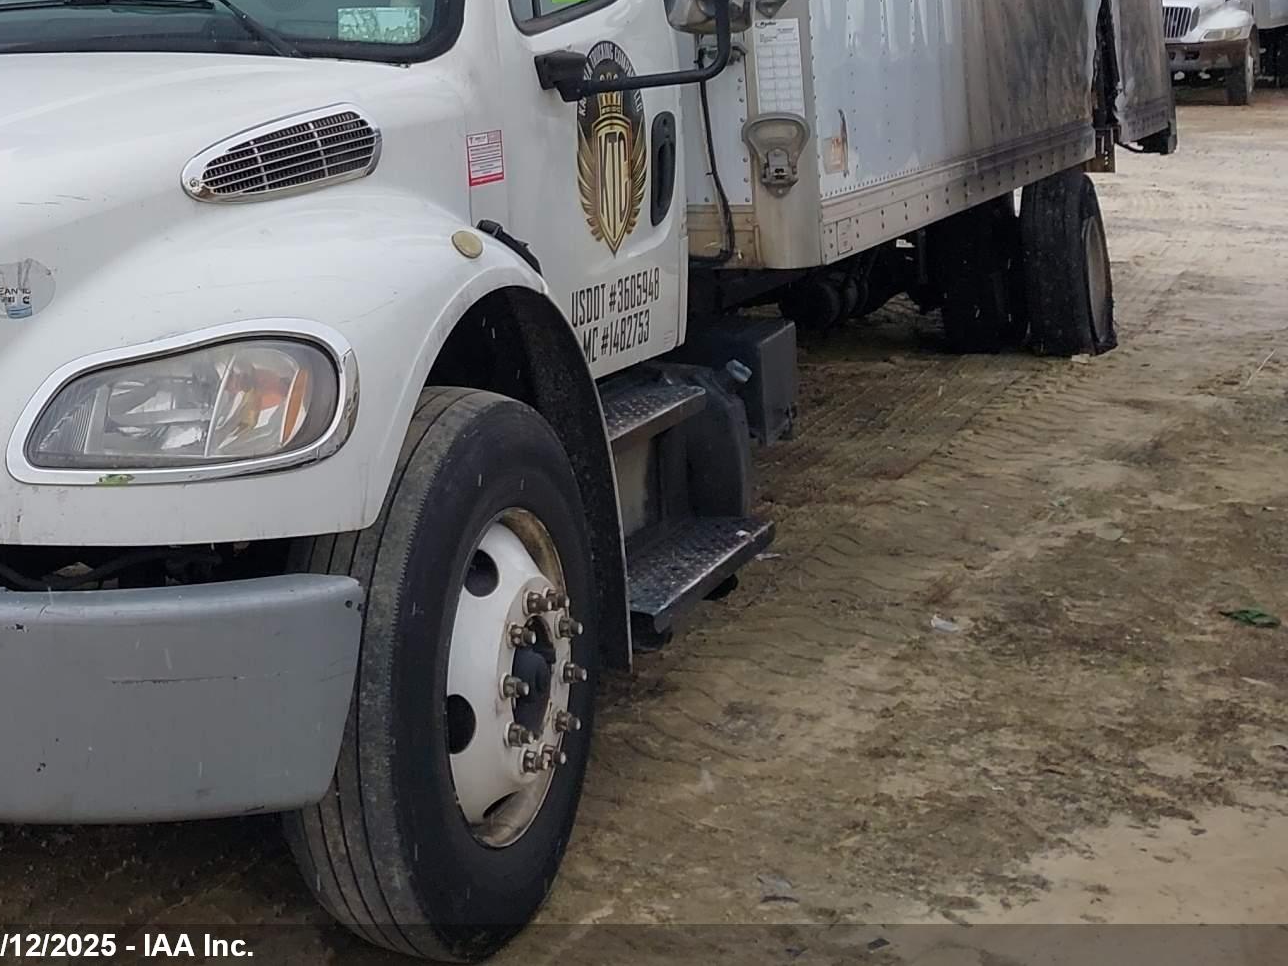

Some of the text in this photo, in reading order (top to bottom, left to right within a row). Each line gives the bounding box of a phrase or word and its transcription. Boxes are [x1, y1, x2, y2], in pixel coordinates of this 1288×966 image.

[571, 267, 660, 328] USDOT #3605948
[601, 308, 650, 356] #1482753
